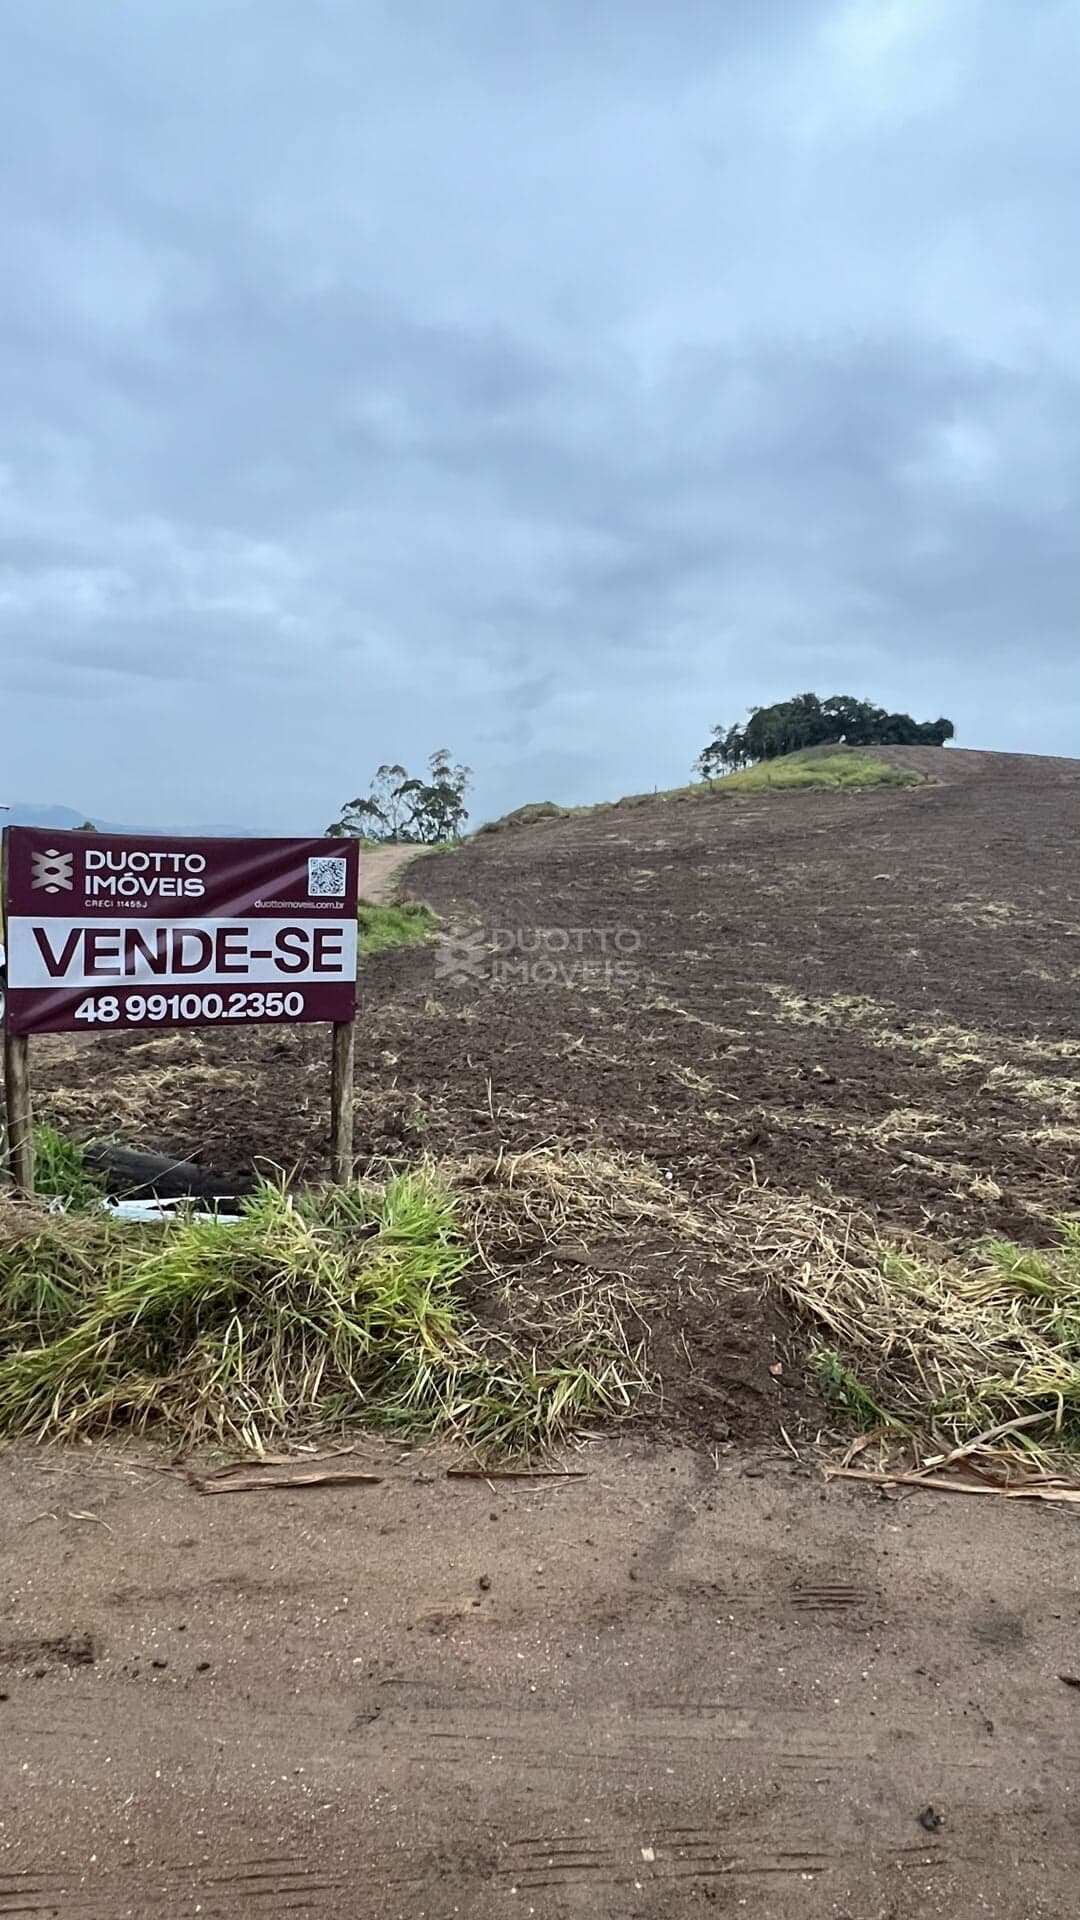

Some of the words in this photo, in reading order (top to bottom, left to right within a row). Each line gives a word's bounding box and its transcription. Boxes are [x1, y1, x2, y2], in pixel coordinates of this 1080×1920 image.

[85, 850, 206, 873] DUOTTO
[85, 873, 206, 897] IMÓVEIS
[85, 899, 114, 908] CRECI
[254, 899, 345, 910] duottoimoveis.com.br
[32, 927, 344, 977] VENDE-SE
[74, 997, 120, 1023] 48
[126, 992, 304, 1022] 99100.2350
